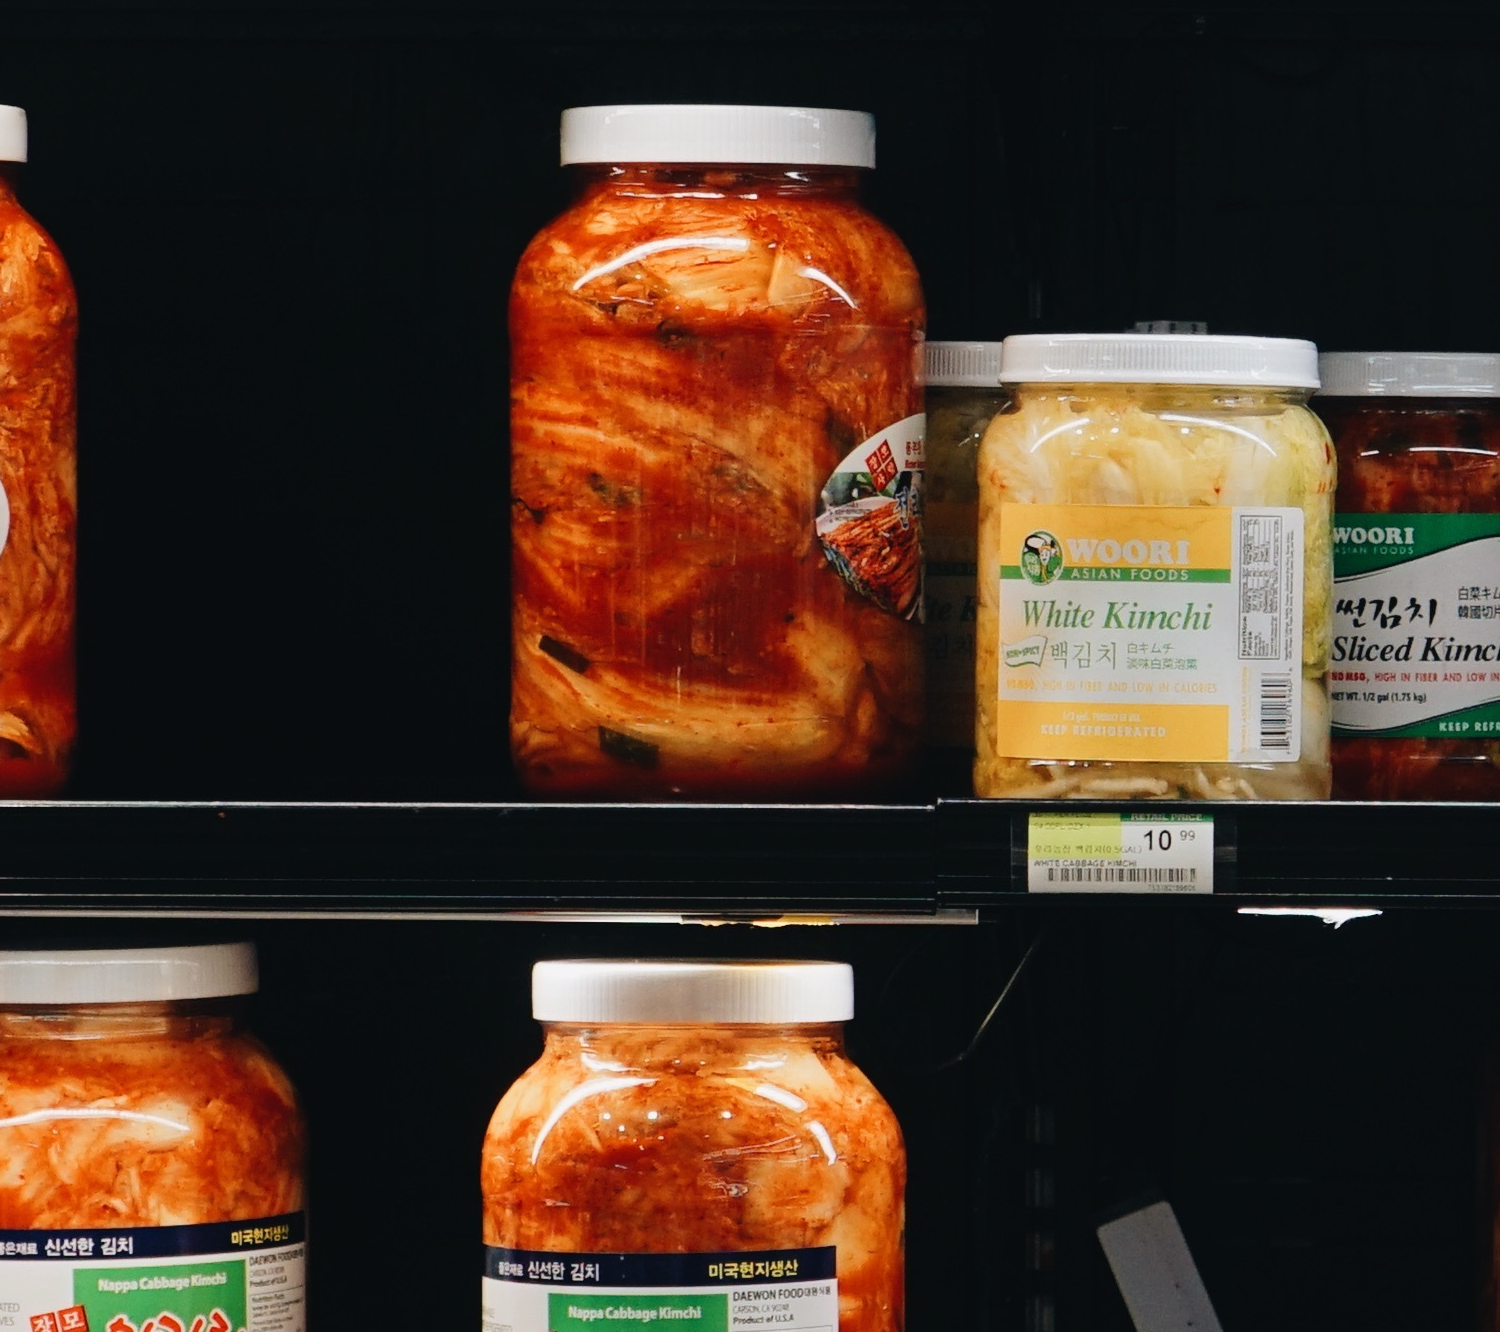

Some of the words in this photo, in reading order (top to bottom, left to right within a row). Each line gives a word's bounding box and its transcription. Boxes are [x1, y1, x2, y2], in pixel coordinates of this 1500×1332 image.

[1066, 538, 1191, 566] WOORI
[1070, 568, 1121, 582] ASIAN
[1127, 567, 1190, 582] FOODS
[1020, 598, 1093, 631] White
[1100, 600, 1212, 636] Kimchi
[1050, 640, 1119, 670] 백김치
[1332, 634, 1414, 666] Sliced
[1144, 829, 1173, 850] 10
[1179, 829, 1196, 842] 99
[708, 1258, 799, 1281] 미국현지생산
